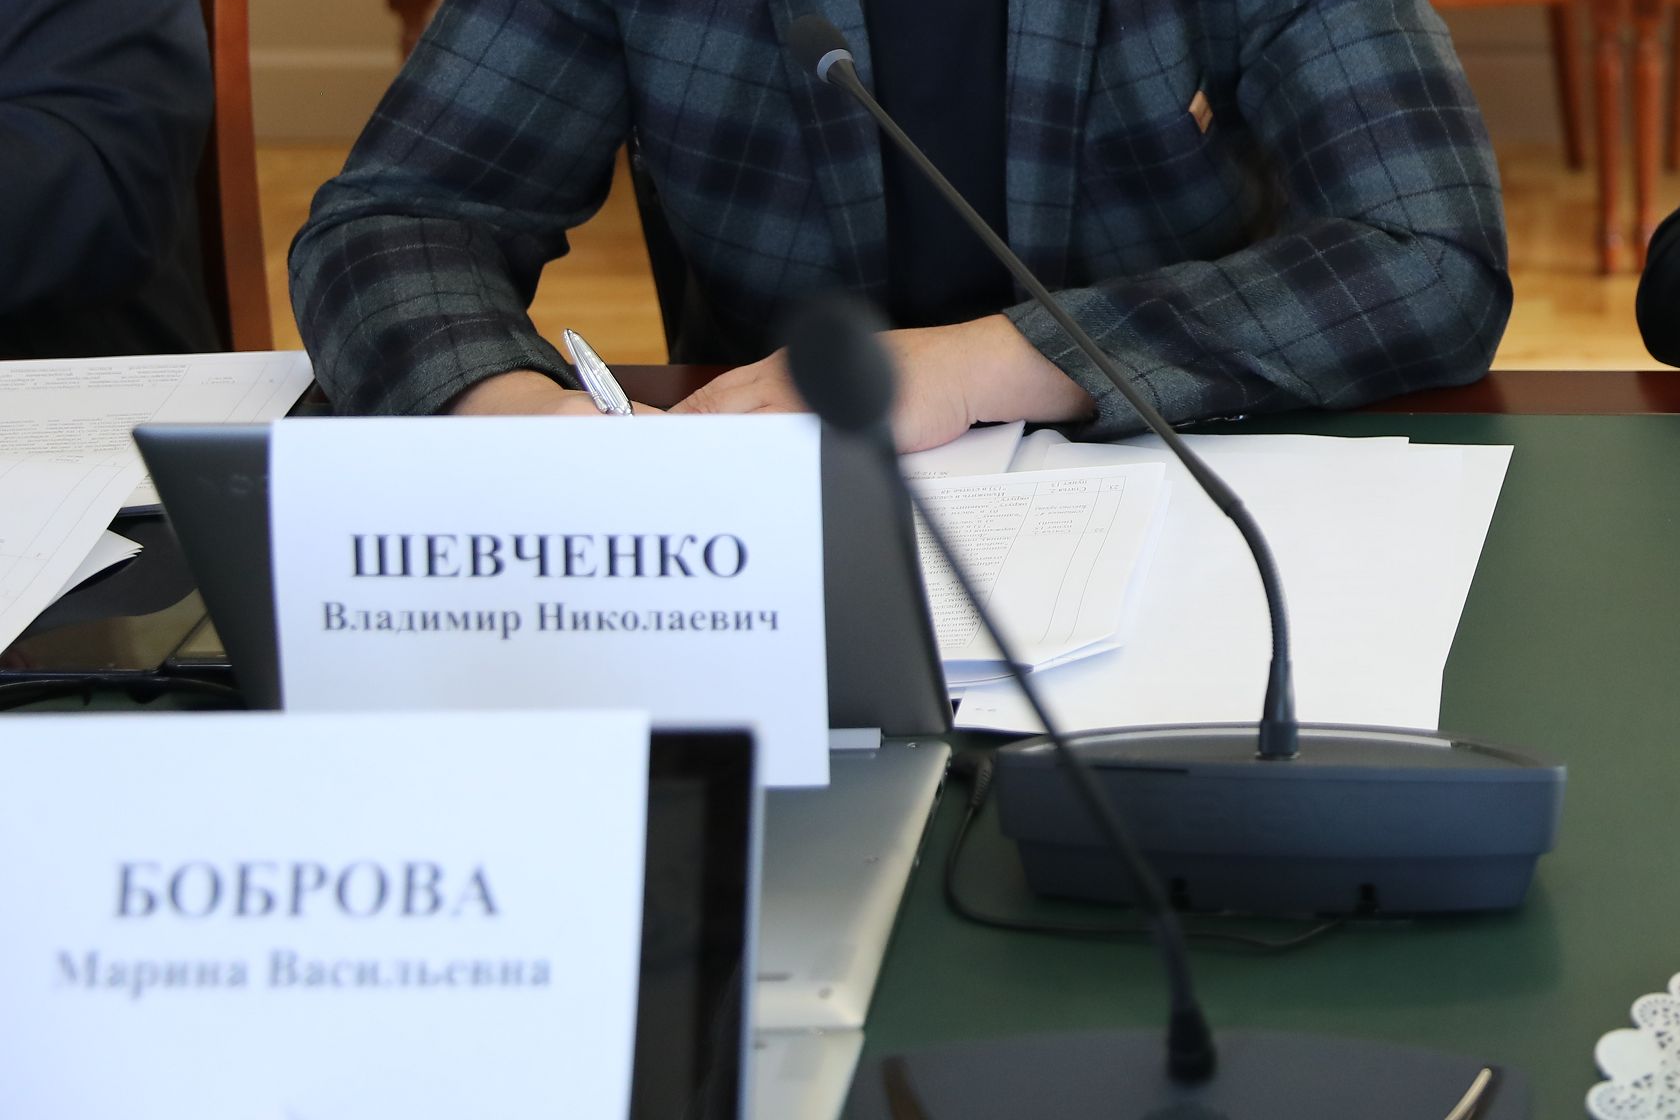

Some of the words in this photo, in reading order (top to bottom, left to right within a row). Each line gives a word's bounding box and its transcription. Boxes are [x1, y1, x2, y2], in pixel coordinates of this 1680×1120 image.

[352, 533, 748, 579] ШЕВЧЕНКО
[323, 601, 522, 642] Владимир
[537, 601, 780, 634] Николаевич
[114, 859, 501, 921] БОБРОВА
[55, 947, 251, 1003] Марина
[264, 946, 552, 992] Васильевна
